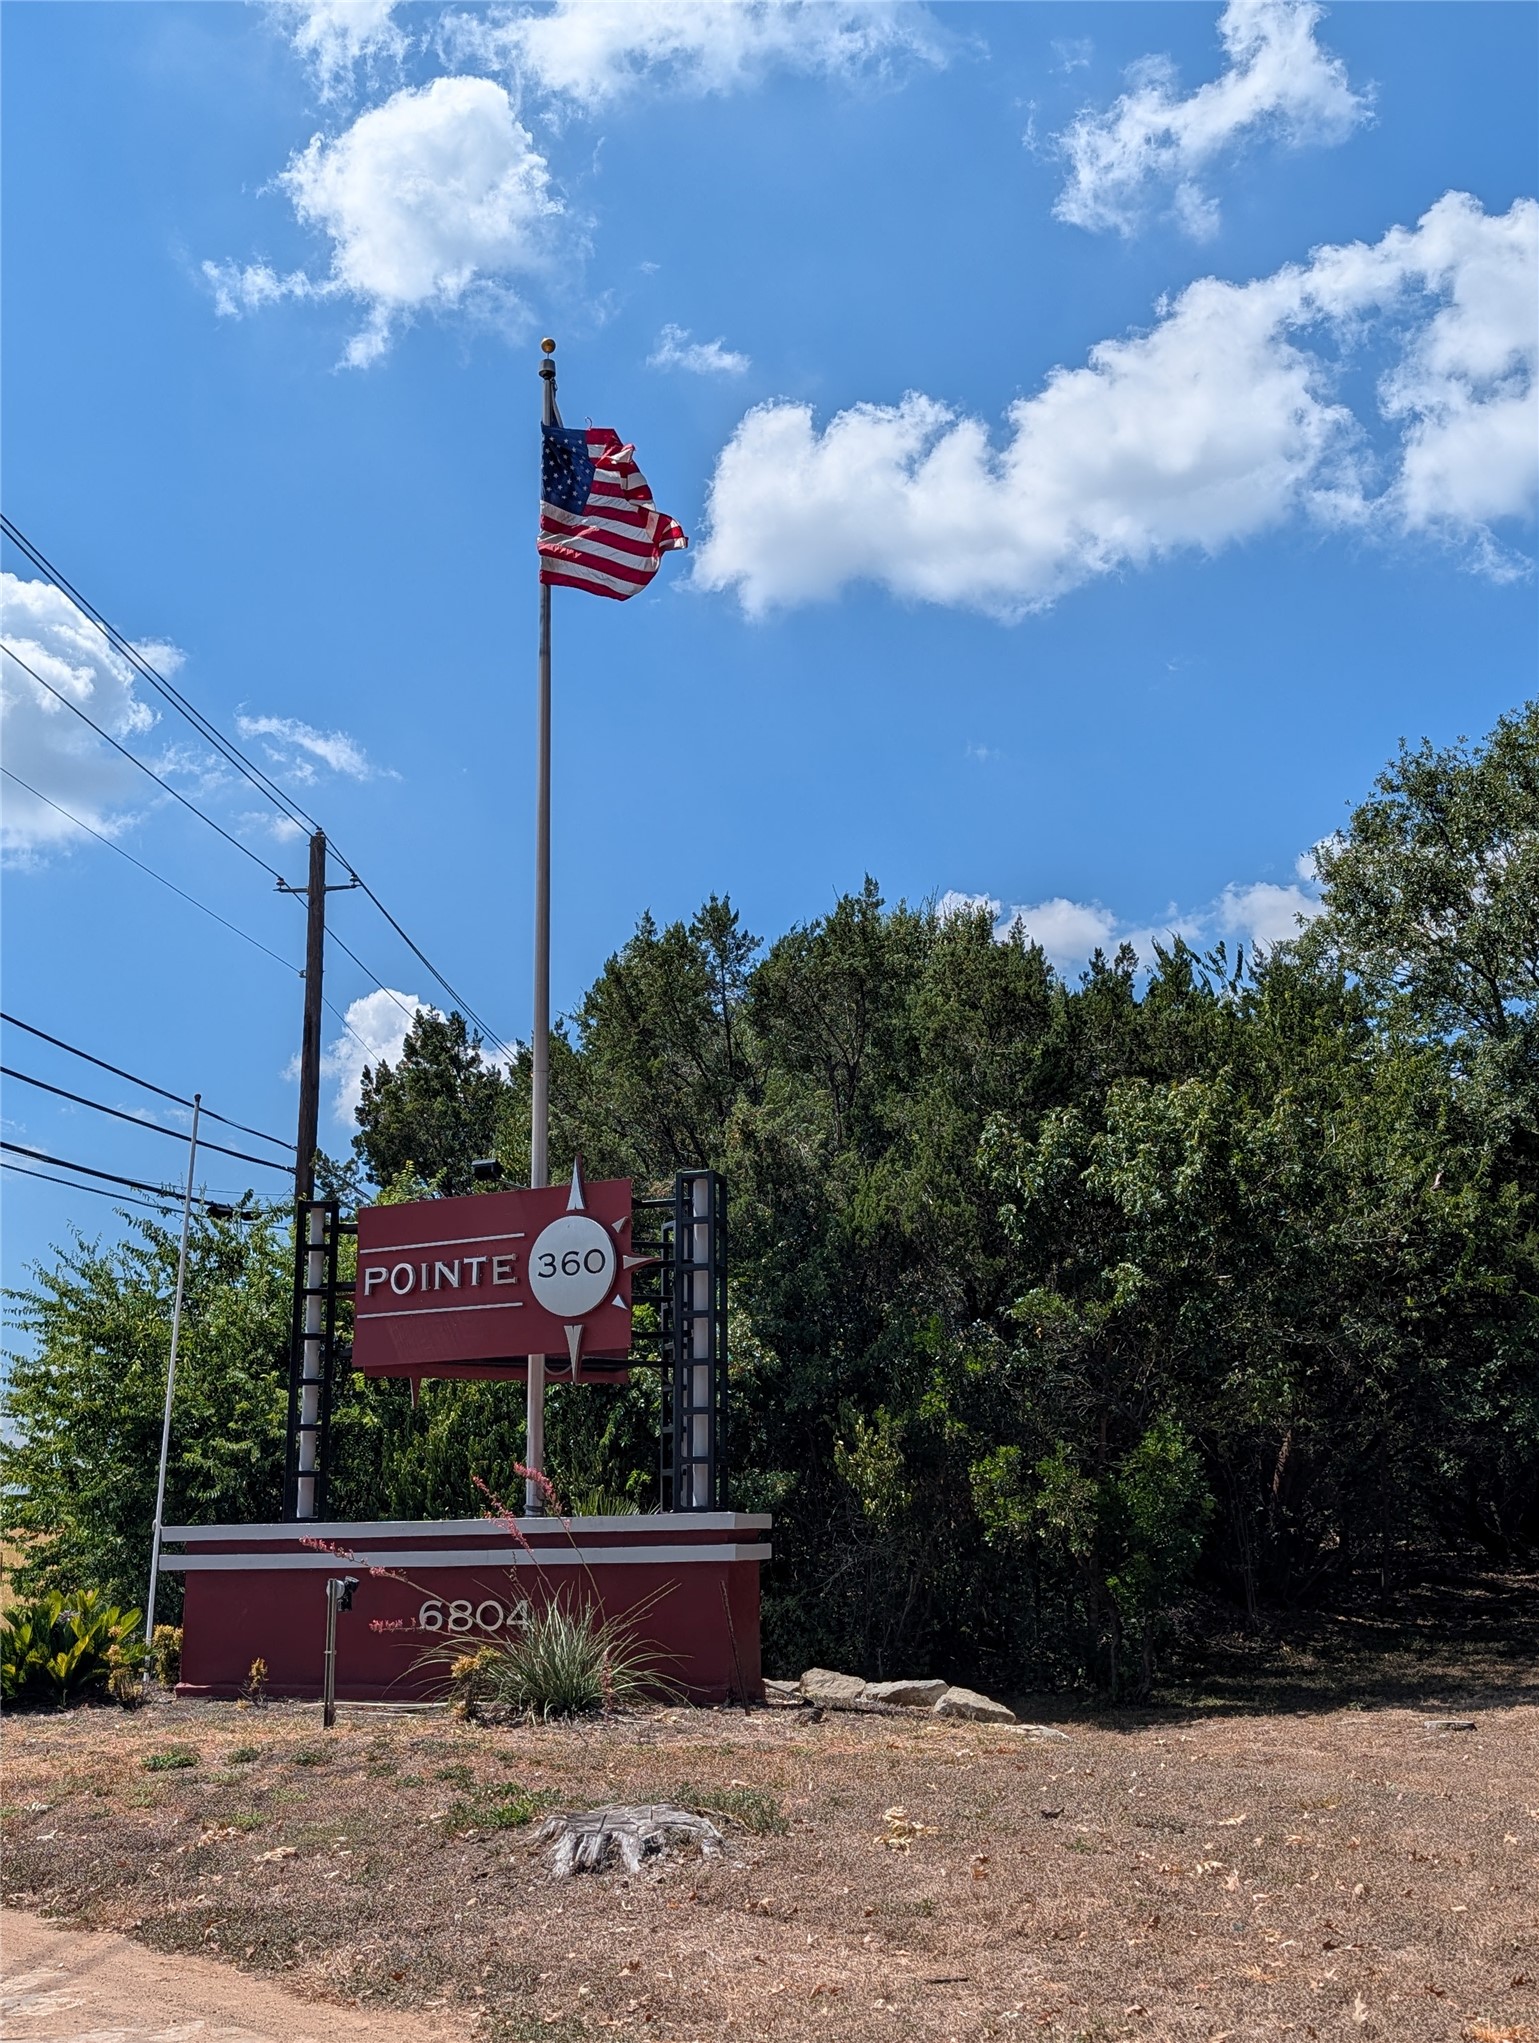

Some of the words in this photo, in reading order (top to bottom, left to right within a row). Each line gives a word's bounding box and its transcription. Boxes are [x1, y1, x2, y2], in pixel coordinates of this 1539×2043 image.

[364, 1253, 518, 1296] POINTE
[537, 1248, 606, 1279] 360
[419, 1600, 530, 1632] 6804
